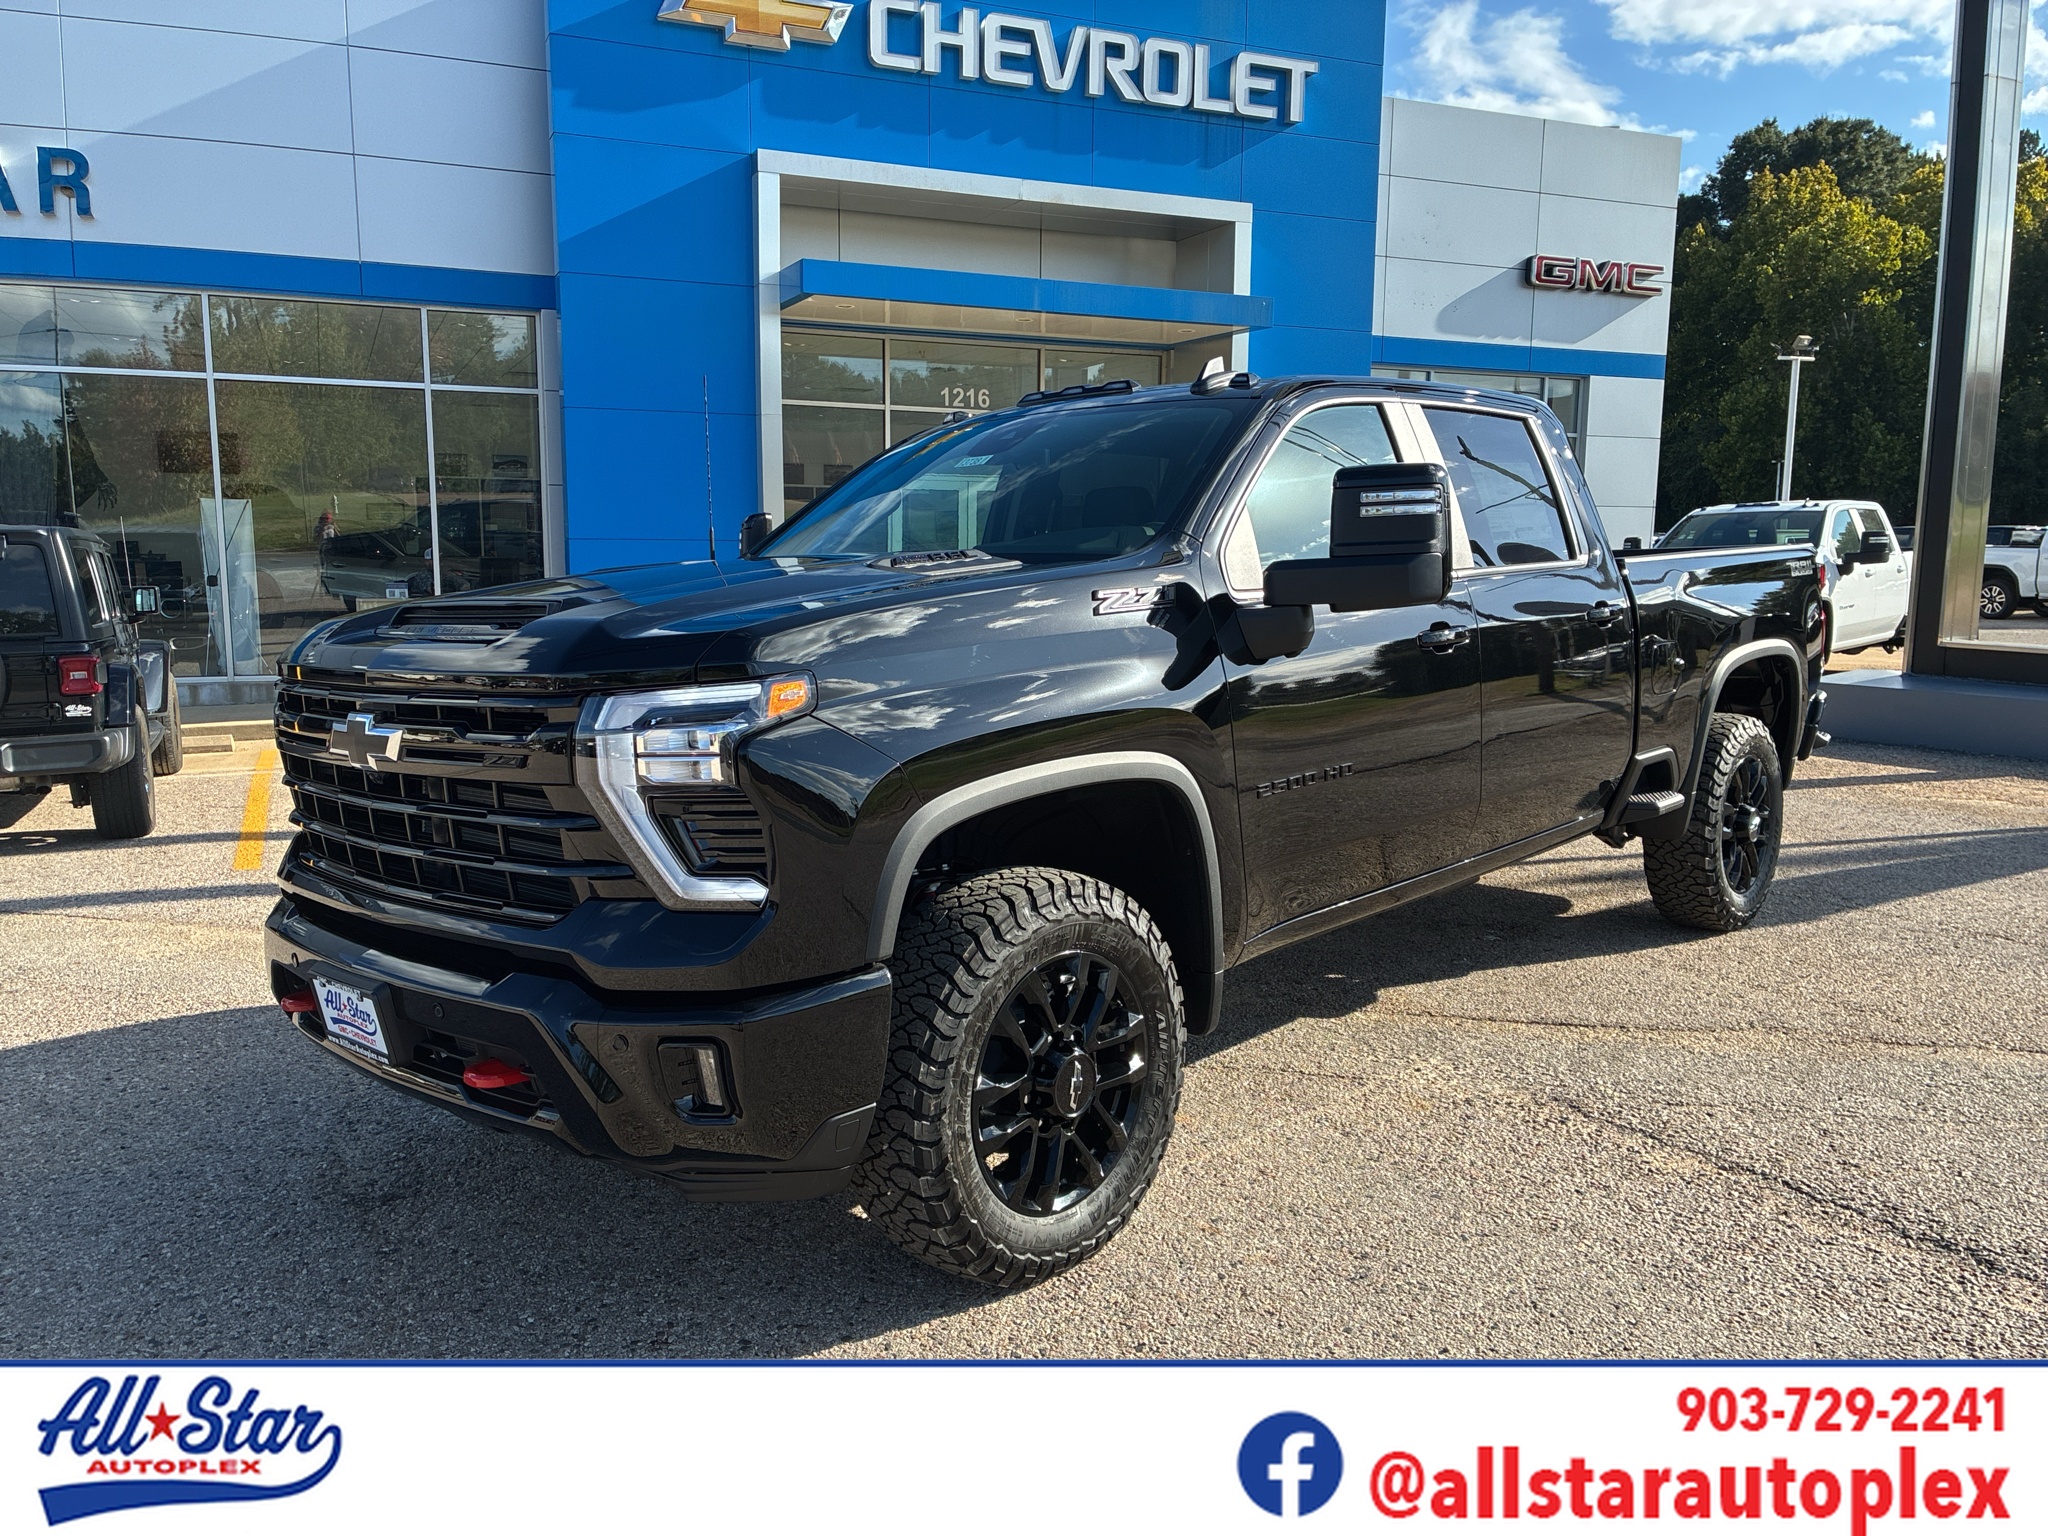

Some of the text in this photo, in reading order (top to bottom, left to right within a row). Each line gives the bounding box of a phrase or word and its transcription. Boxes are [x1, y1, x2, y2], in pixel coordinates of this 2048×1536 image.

[868, 0, 1320, 125] CHEVROLET
[1527, 254, 1665, 297] GMC
[940, 387, 990, 408] 1216
[1257, 763, 1353, 799] 2500 HD
